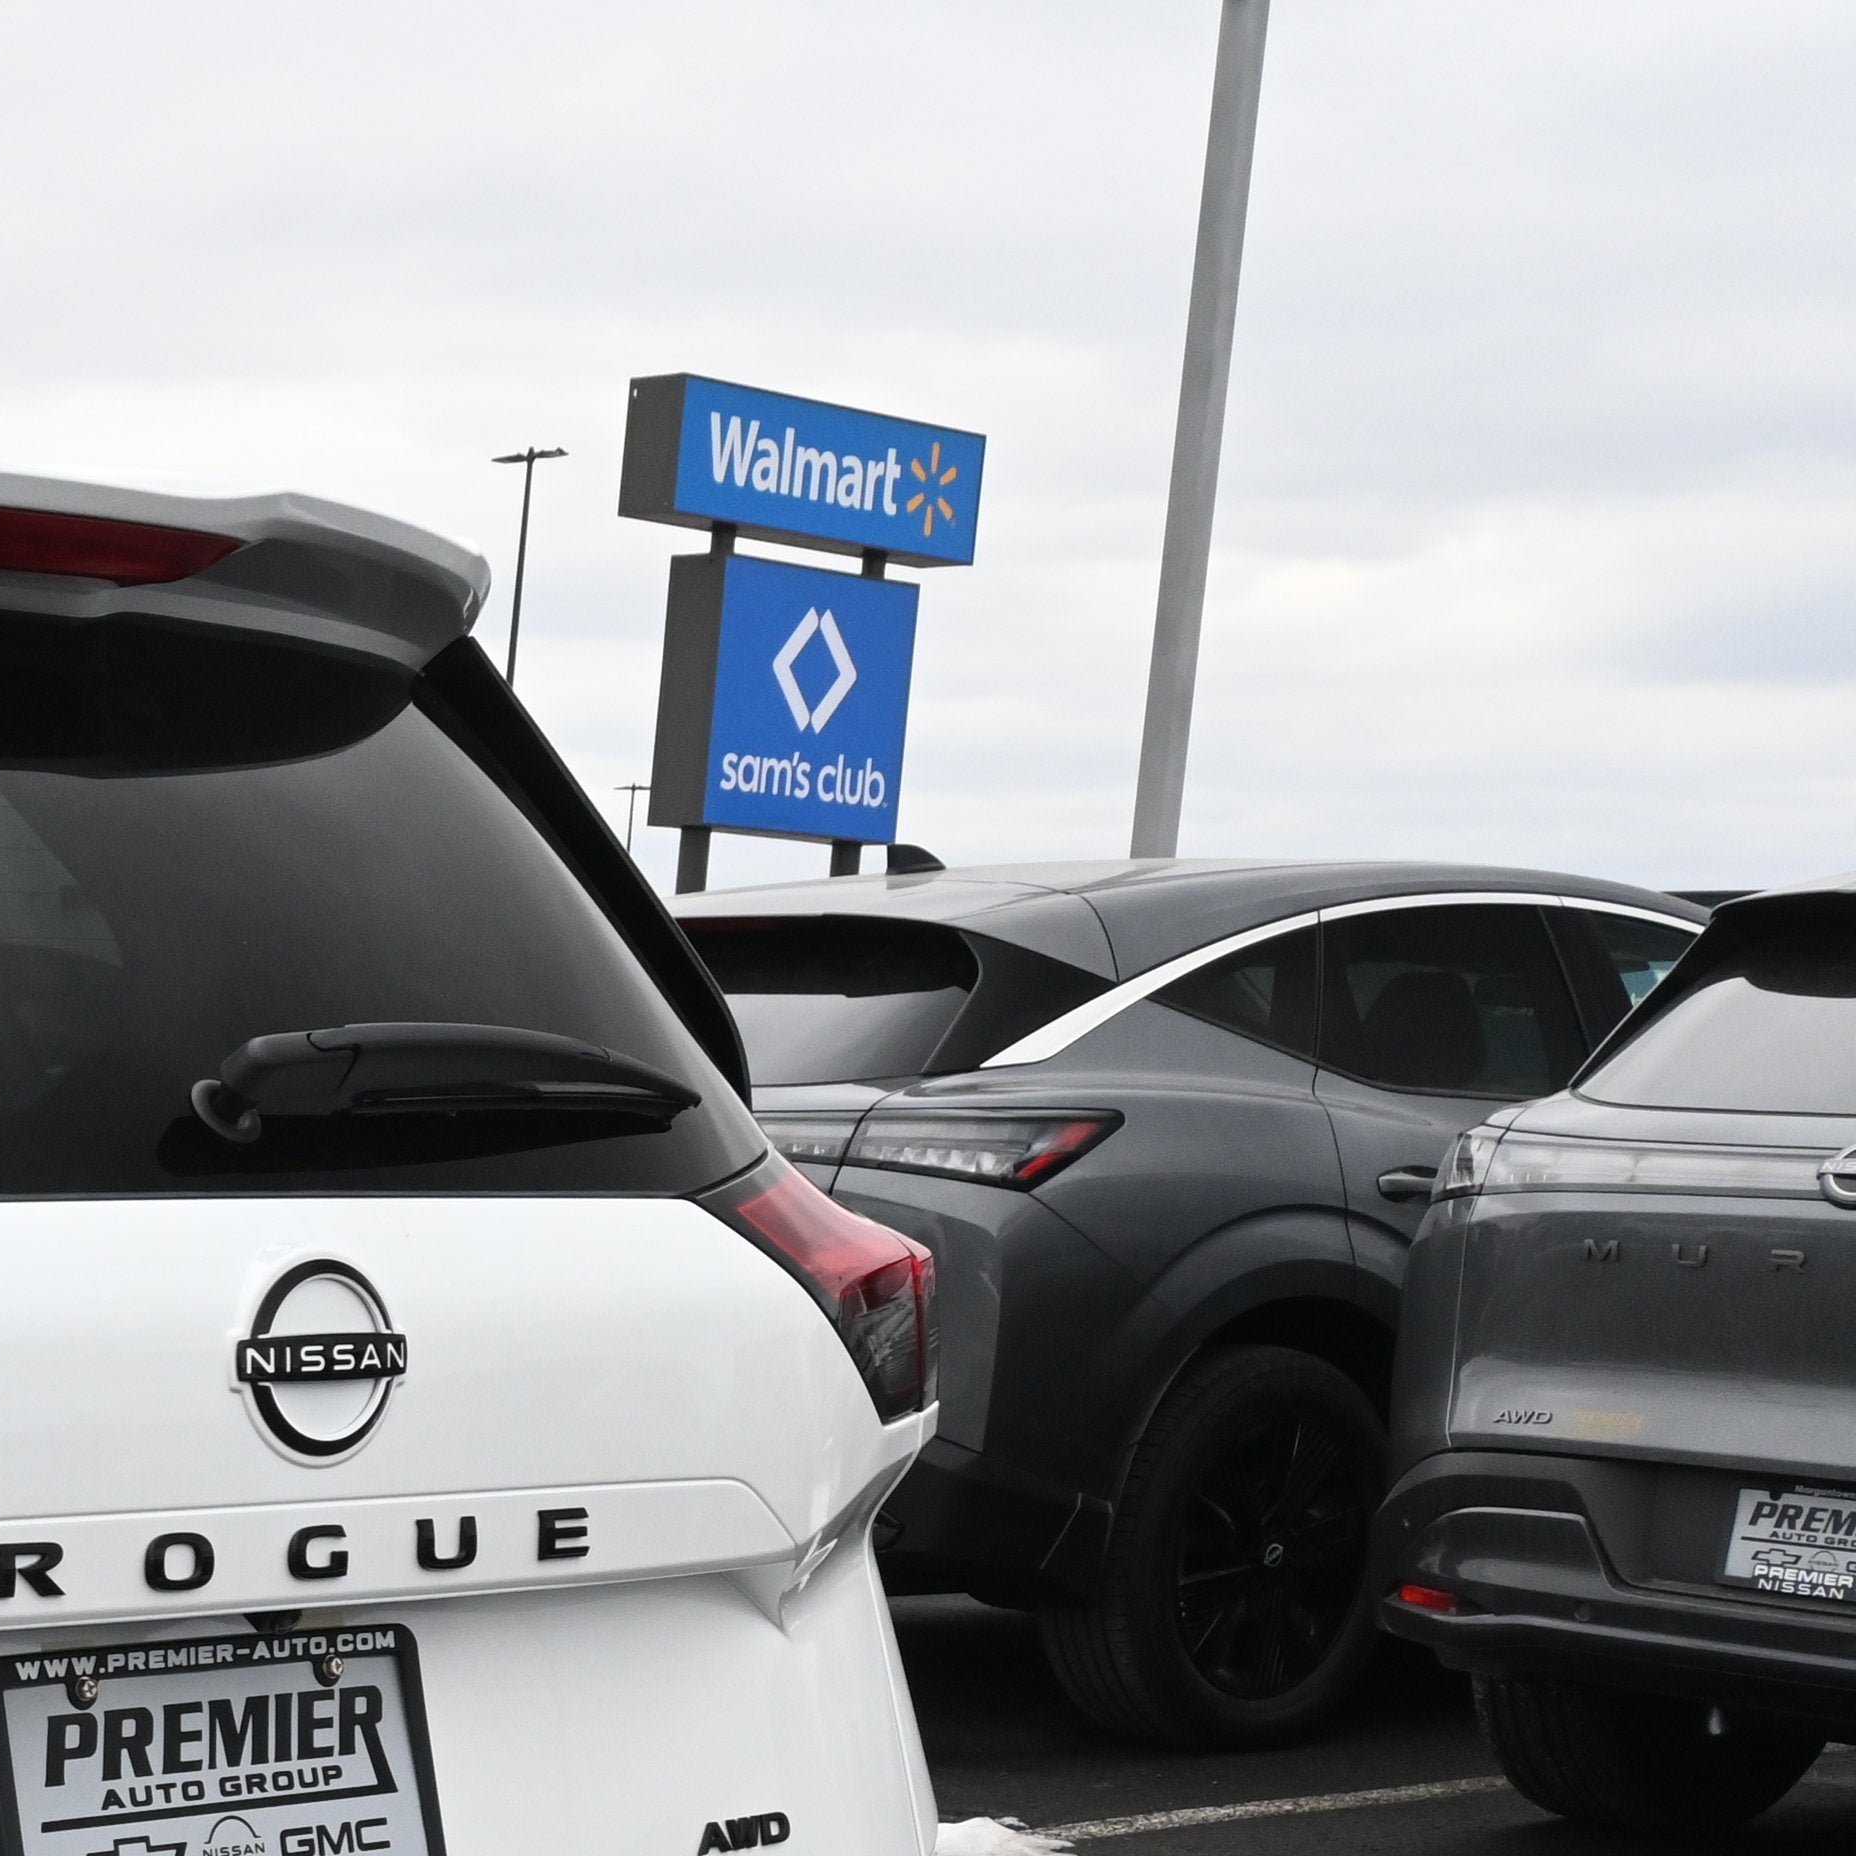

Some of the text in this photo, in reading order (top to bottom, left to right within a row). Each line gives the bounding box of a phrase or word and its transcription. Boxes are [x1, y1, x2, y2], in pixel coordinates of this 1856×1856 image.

[710, 411, 901, 516] Walmart
[720, 751, 885, 807] sam's club
[1584, 1238, 1807, 1274] MUR
[245, 1340, 406, 1374] NISSAN
[1493, 1410, 1553, 1425] AWD
[1748, 1501, 1856, 1537] PREM
[1769, 1530, 1818, 1543] AUTO
[1754, 1565, 1854, 1588] PREMIER
[1757, 1578, 1845, 1600] NISSAN
[15, 1630, 396, 1681] WWW.PREMIER-AUTO.COM
[44, 1684, 398, 1790] PREMIER
[101, 1764, 344, 1811] AUTO GROUP
[697, 1811, 790, 1856] AWD
